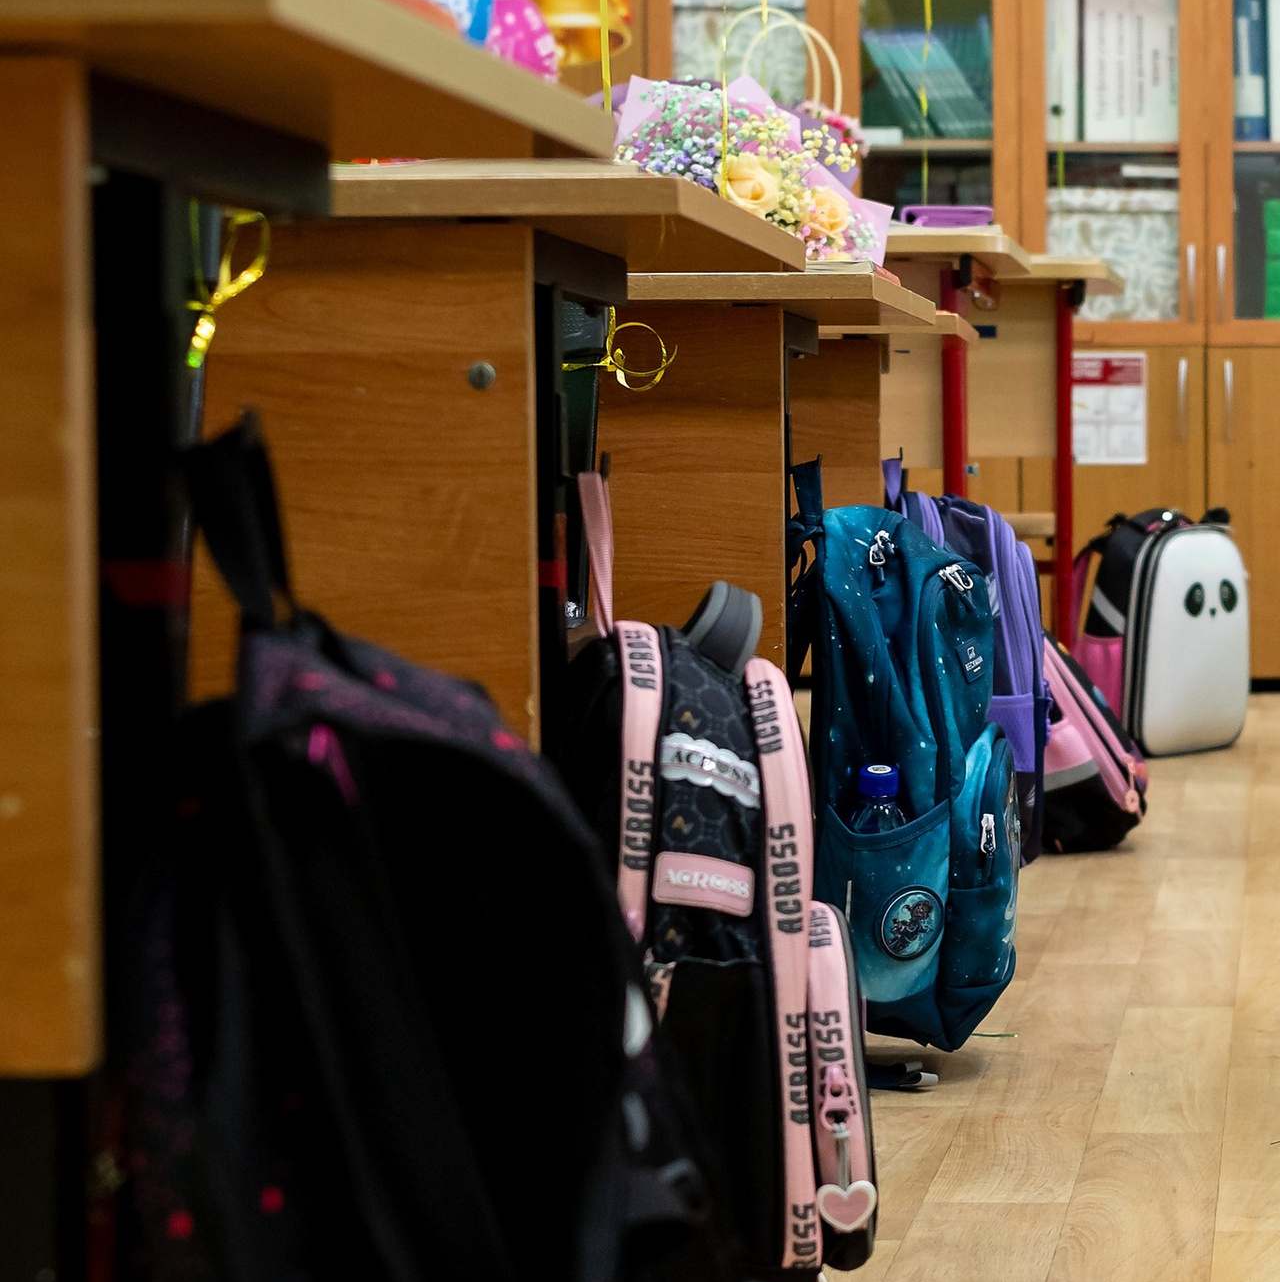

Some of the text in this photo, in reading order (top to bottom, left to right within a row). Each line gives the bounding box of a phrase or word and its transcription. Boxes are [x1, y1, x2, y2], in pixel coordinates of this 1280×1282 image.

[749, 679, 784, 755] ACROSS
[623, 760, 654, 870] ACROSS
[769, 822, 803, 934] ACROSS
